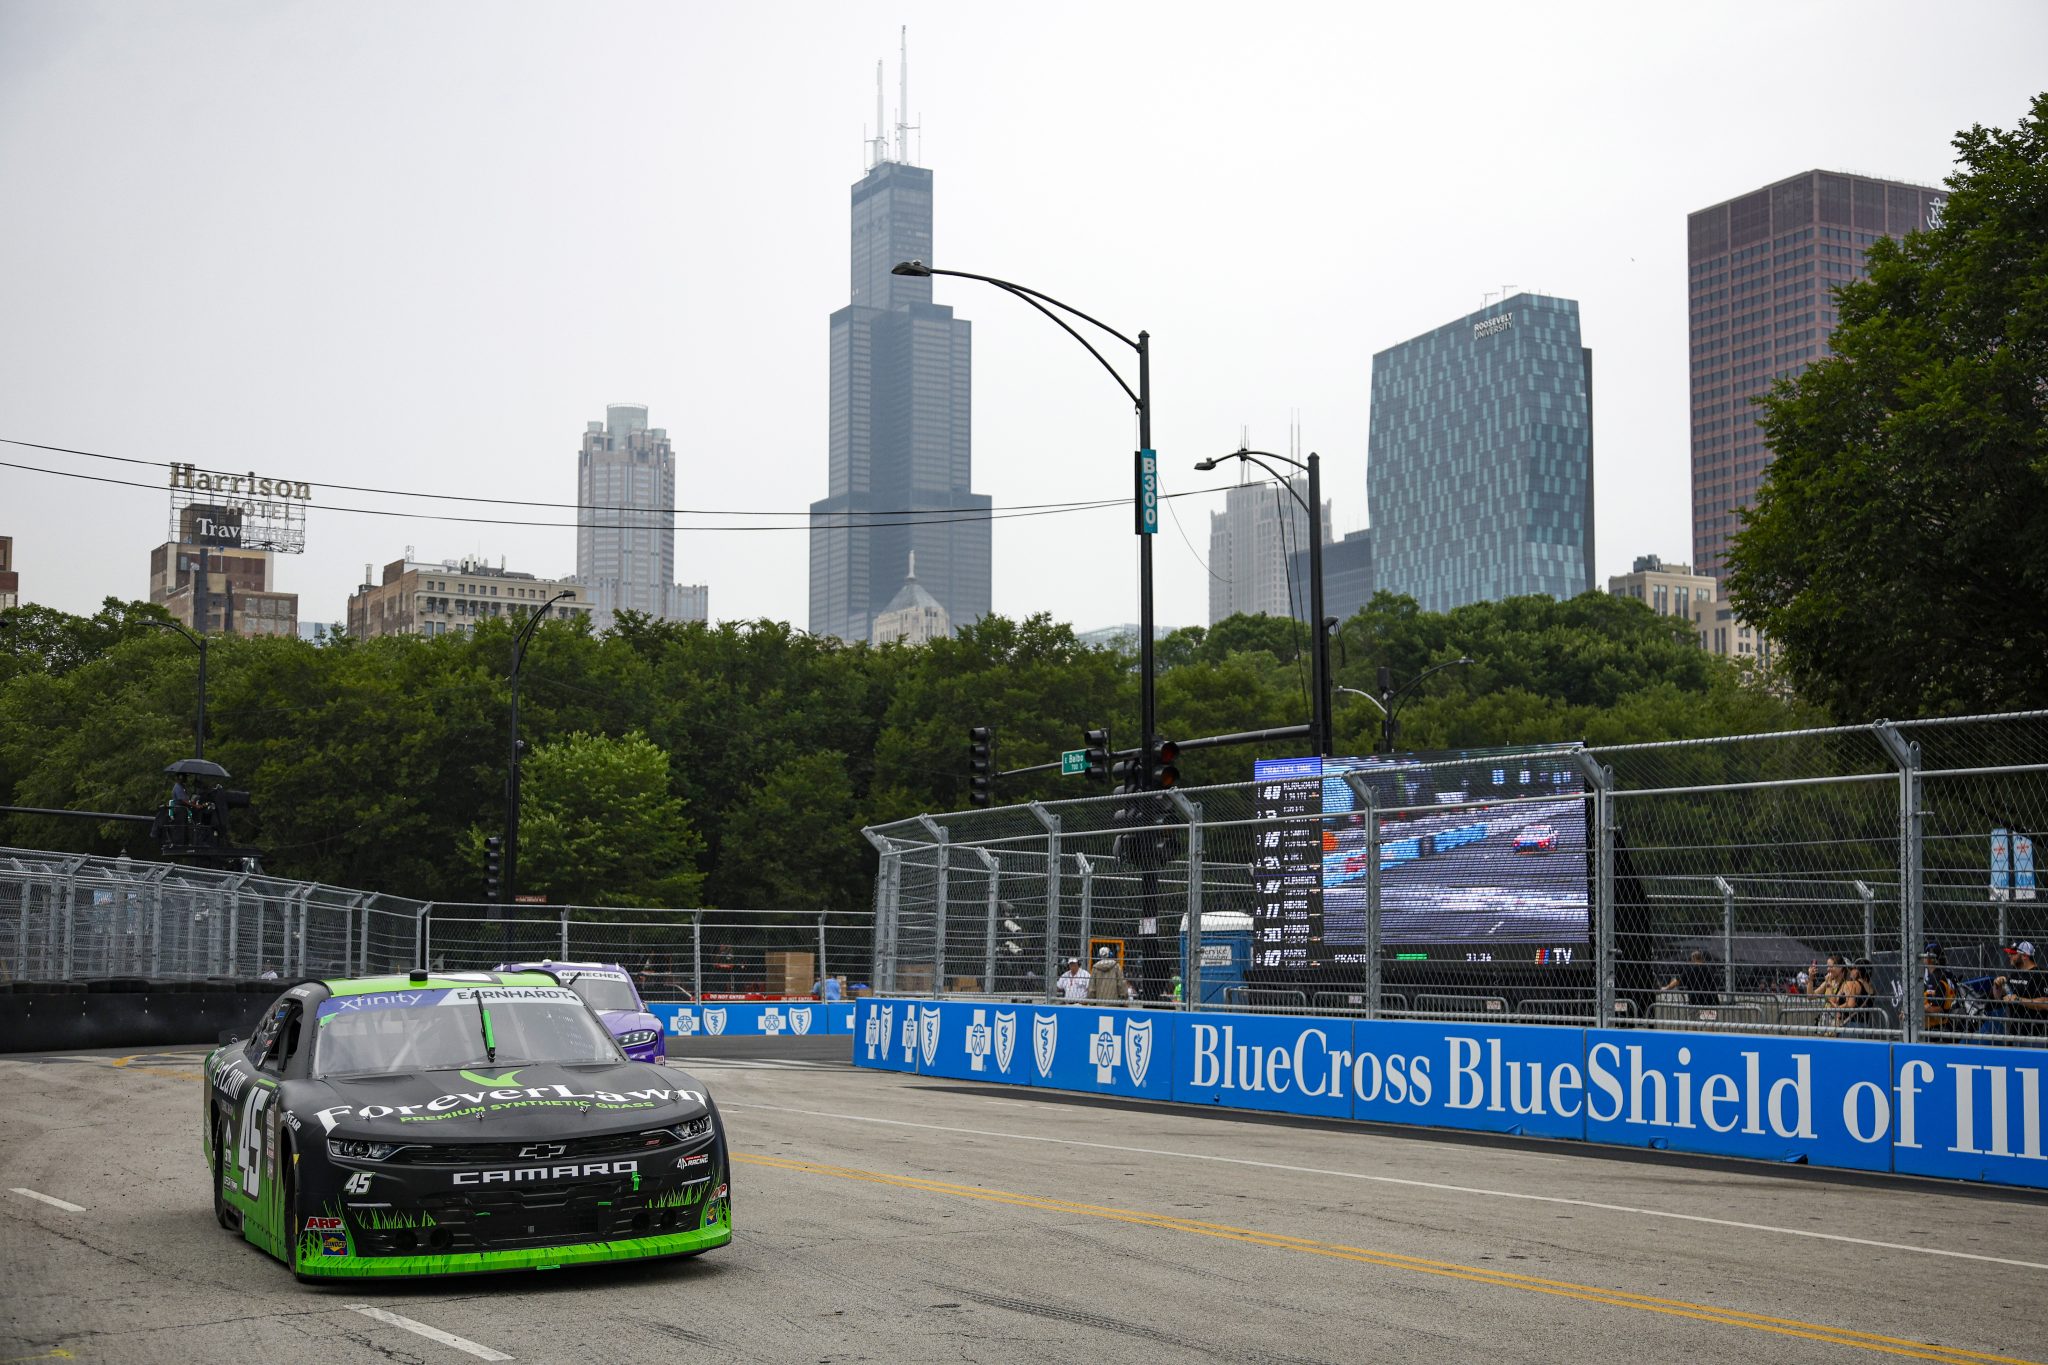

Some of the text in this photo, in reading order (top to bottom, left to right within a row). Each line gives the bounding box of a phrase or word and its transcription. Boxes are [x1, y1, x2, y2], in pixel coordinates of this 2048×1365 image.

[1474, 312, 1513, 332] ROOSEVELT
[1474, 321, 1513, 340] UNIVERSITY
[170, 462, 312, 500] Harrison
[1143, 457, 1156, 525] B300
[226, 499, 295, 521] HOTEL
[1264, 831, 1281, 847] 16
[1264, 928, 1281, 942] 50
[1264, 949, 1281, 966] 10
[1553, 947, 1572, 964] TV
[339, 988, 569, 1011] xfinity EARNHARDT
[1190, 1024, 1433, 1106] BlueCross
[1444, 1036, 1818, 1140] BlueShield
[1843, 1059, 1934, 1149] of
[313, 1084, 708, 1136] ForeverLawn
[399, 1100, 655, 1124] PREMIUM SYNTHETIC GRASS
[238, 1086, 270, 1198] 45
[344, 1172, 375, 1194] 45
[453, 1160, 638, 1185] CAMARO
[307, 1217, 342, 1229] ARP
